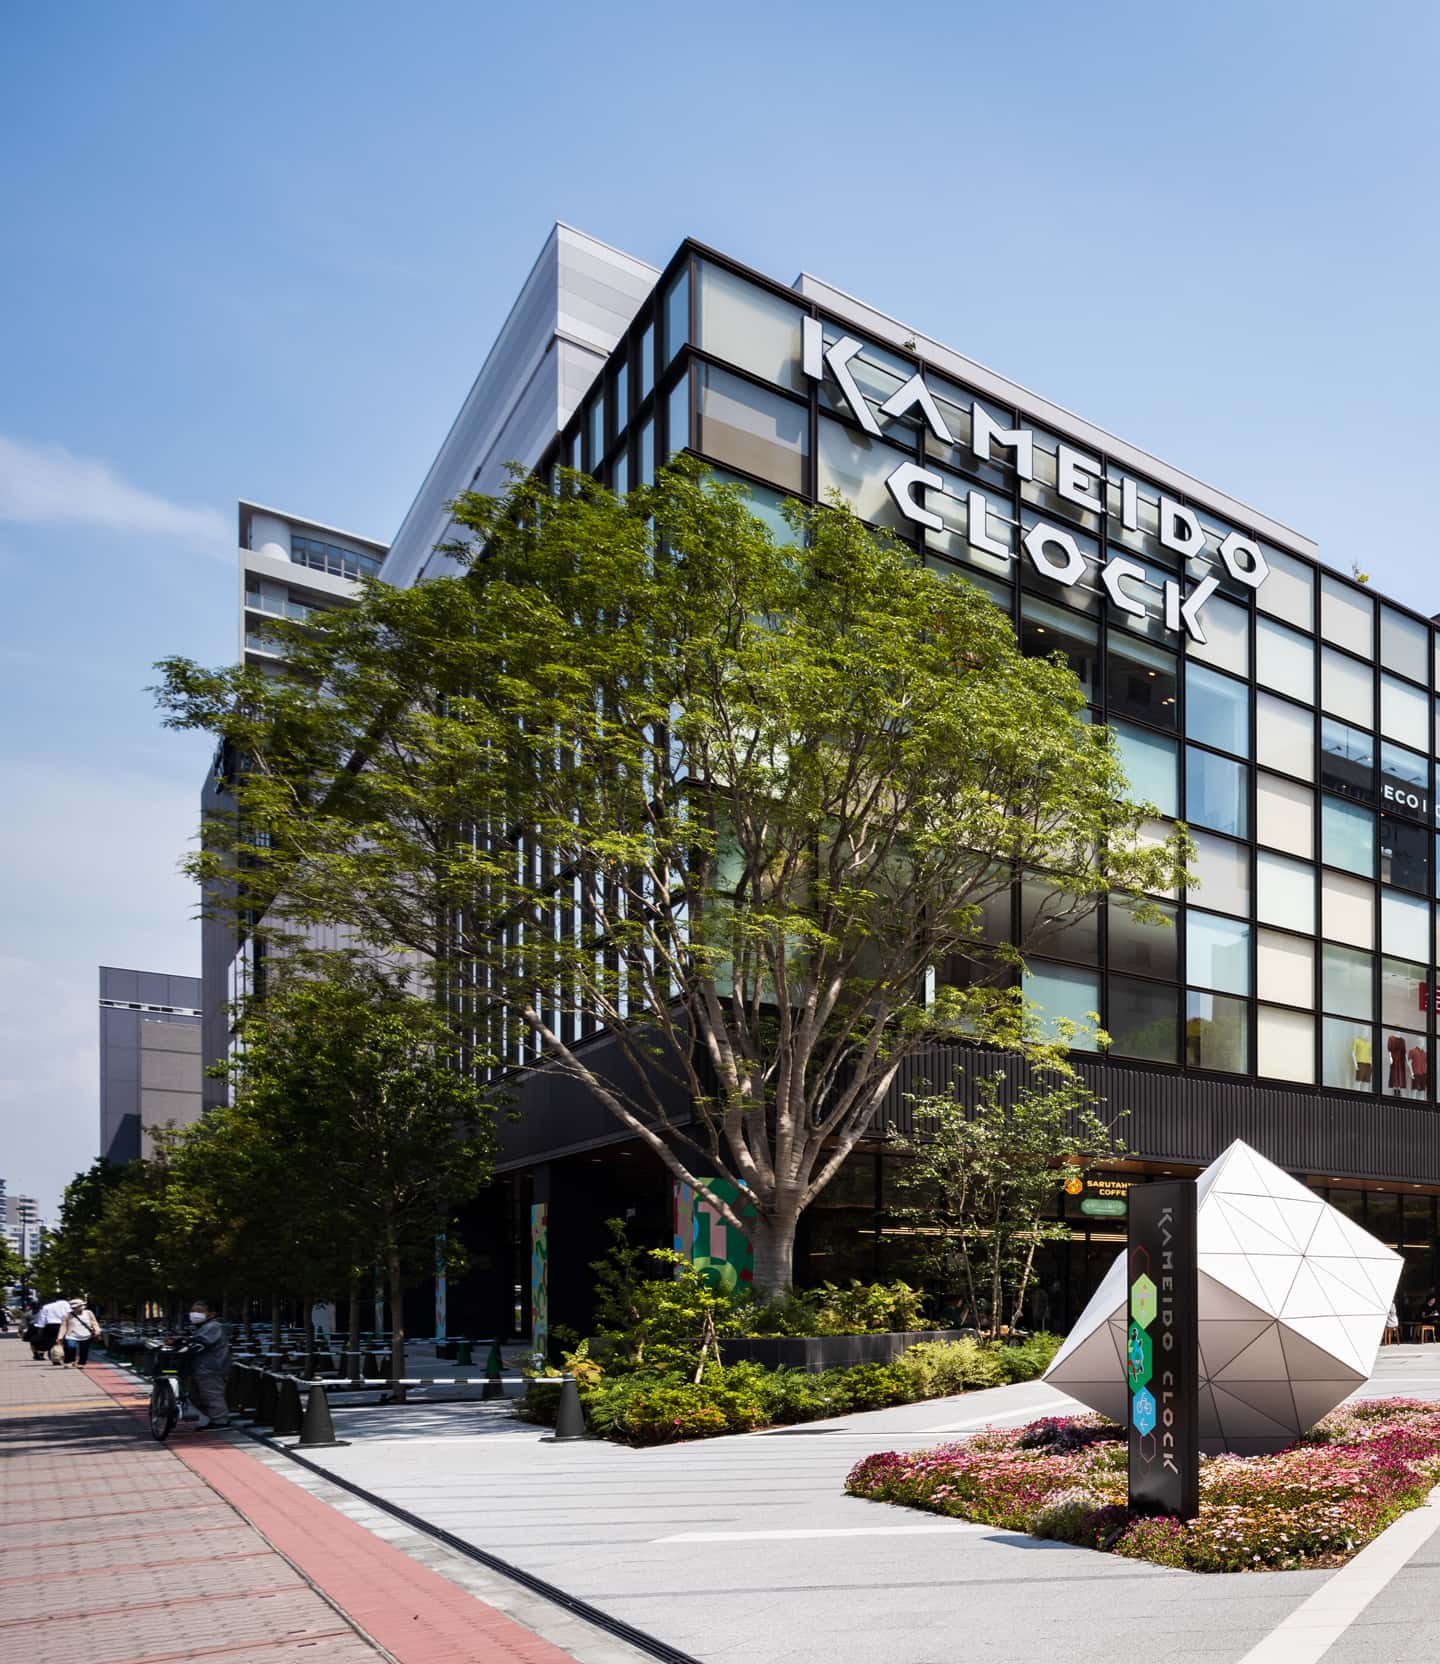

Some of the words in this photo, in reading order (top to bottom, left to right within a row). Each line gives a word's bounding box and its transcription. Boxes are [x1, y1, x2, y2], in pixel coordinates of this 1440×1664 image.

[803, 316, 1270, 588] KAMEIDO
[885, 461, 1219, 644] CLOCK
[1381, 785, 1418, 808] ECO
[1157, 1207, 1173, 1351] KAMEIDO
[1162, 1370, 1178, 1474] CLOCK
